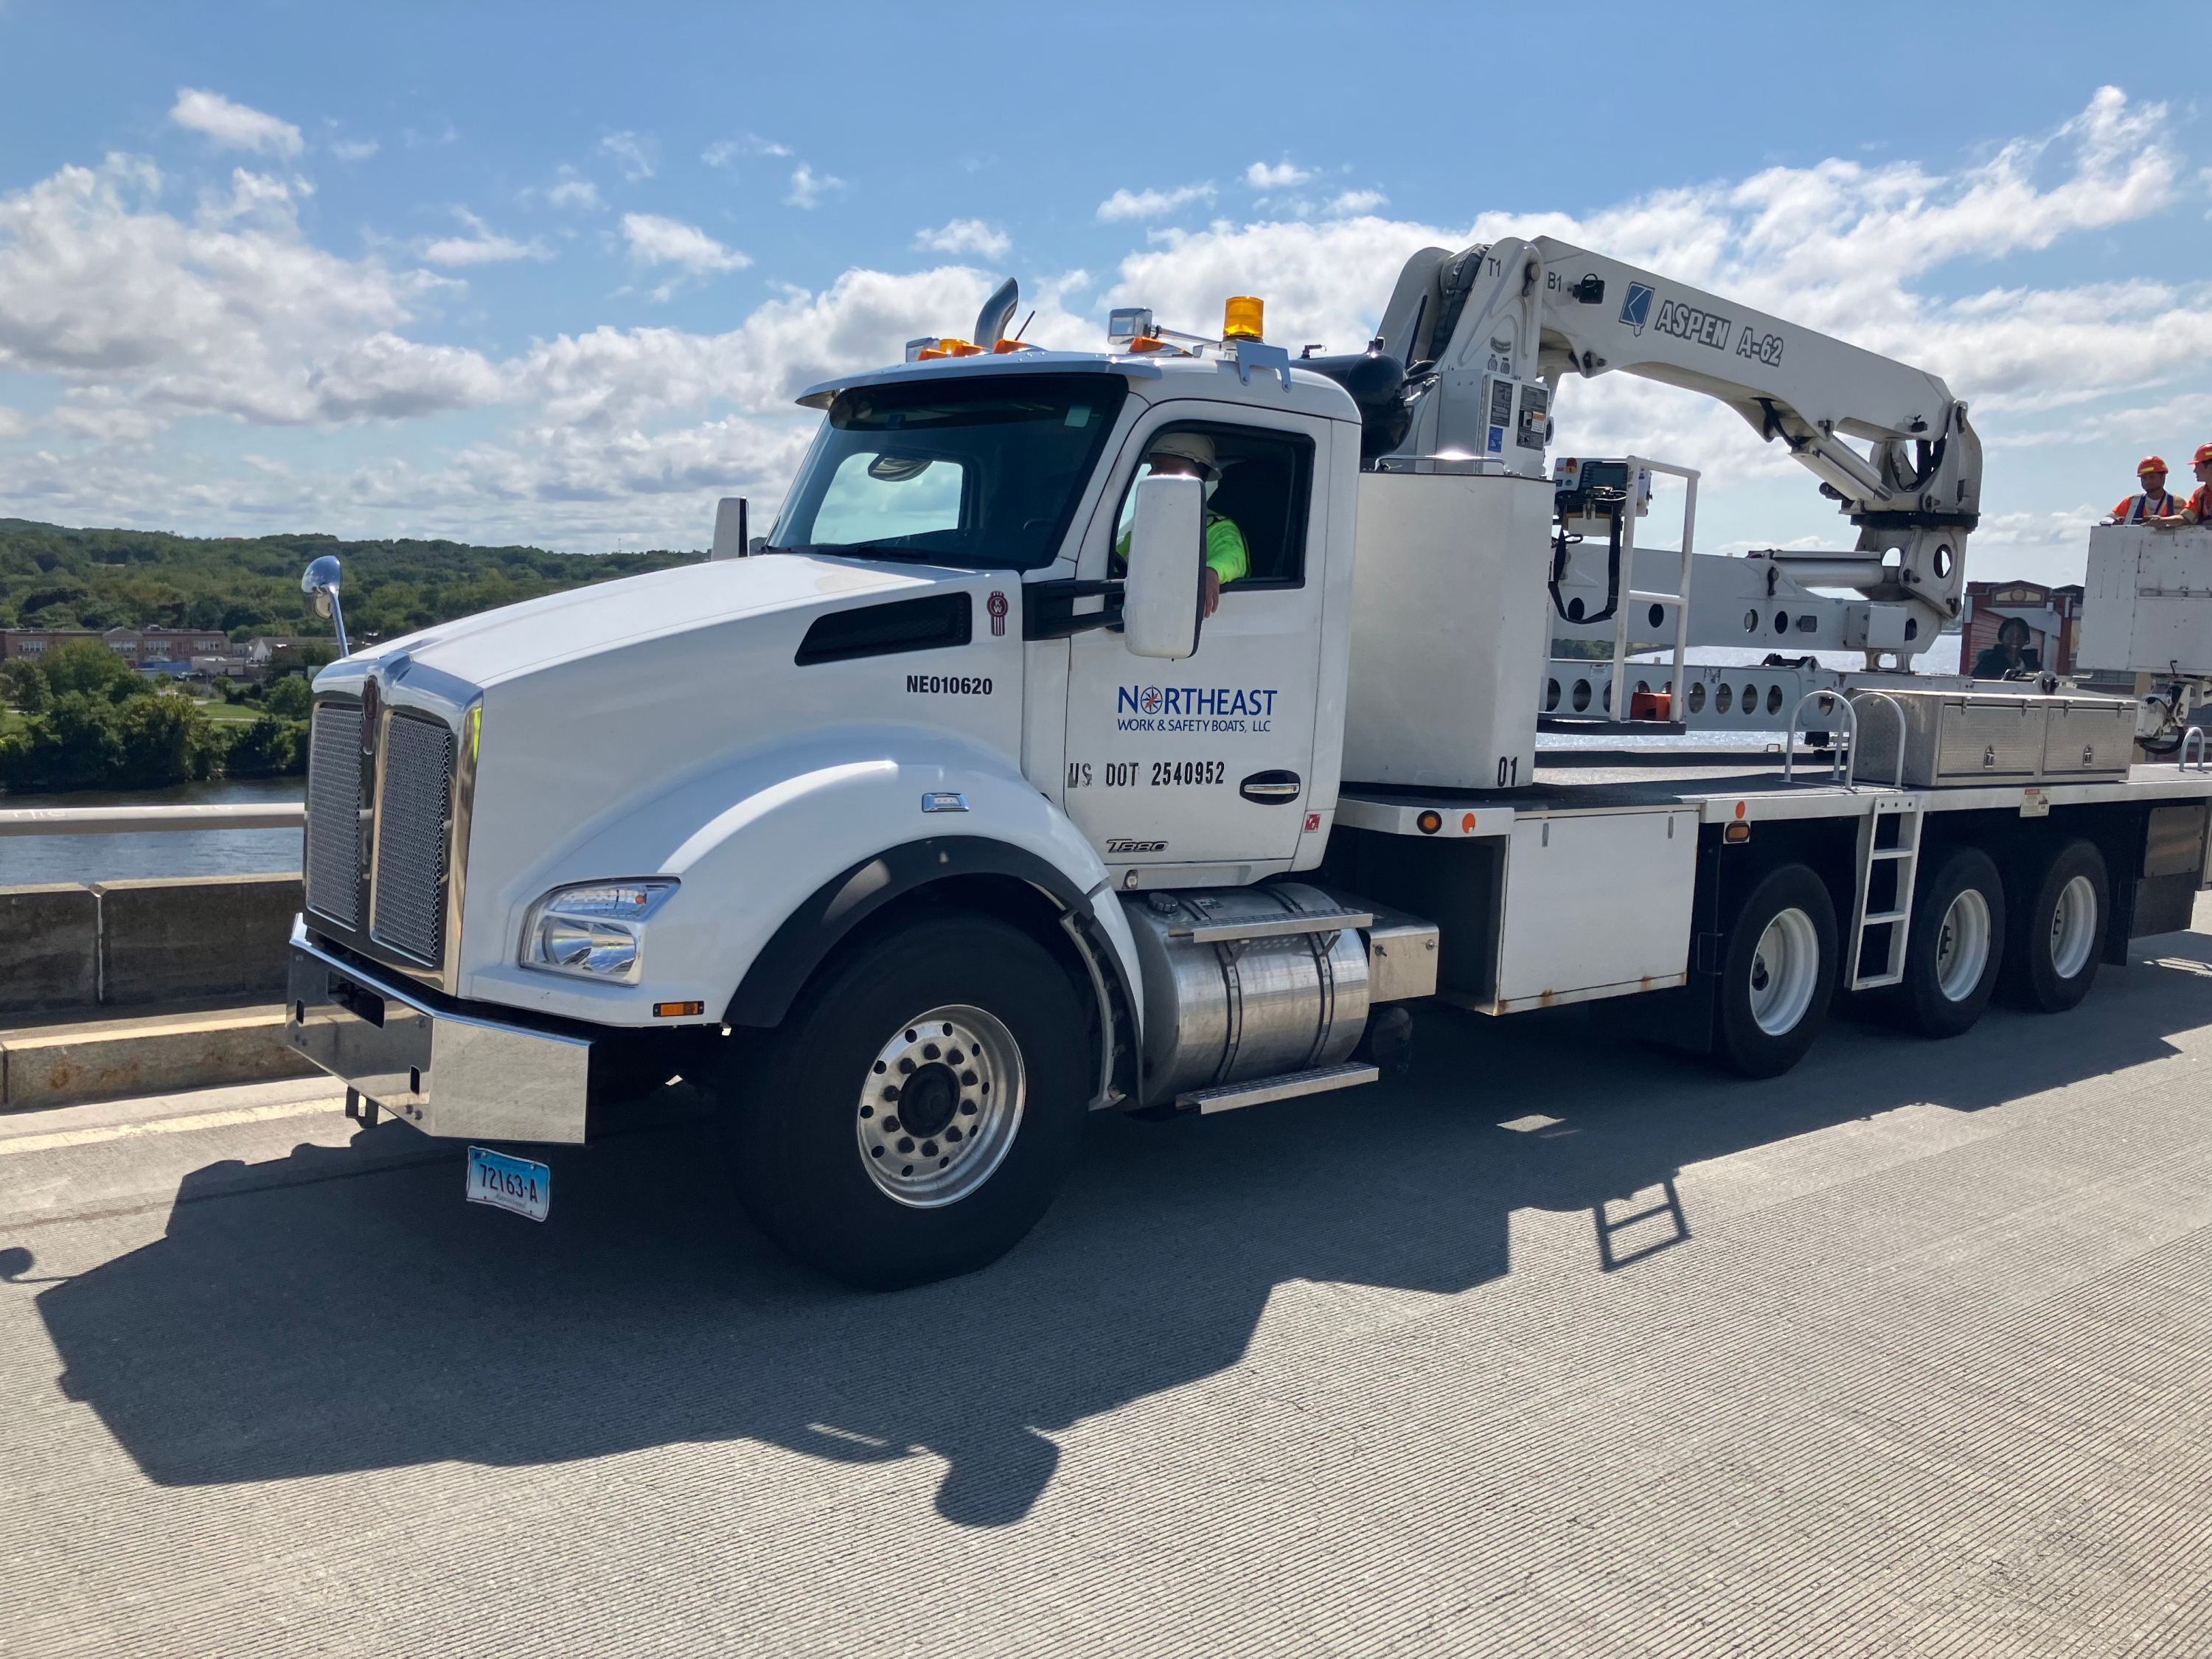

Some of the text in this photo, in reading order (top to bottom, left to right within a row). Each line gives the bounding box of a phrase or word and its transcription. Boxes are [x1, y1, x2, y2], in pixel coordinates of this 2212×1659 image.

[1488, 258, 1501, 277] T1
[1548, 271, 1562, 292] B1
[1654, 299, 1784, 367] ASPEN A-62
[906, 675, 992, 695] NE010620
[1118, 686, 1278, 716] NORTHEAST
[1118, 718, 1271, 733] WORK & SAFETY BOATS, LLC
[1068, 761, 1225, 787] US DOT 2540952
[1498, 757, 1517, 787] 01
[1106, 838, 1169, 853] T880
